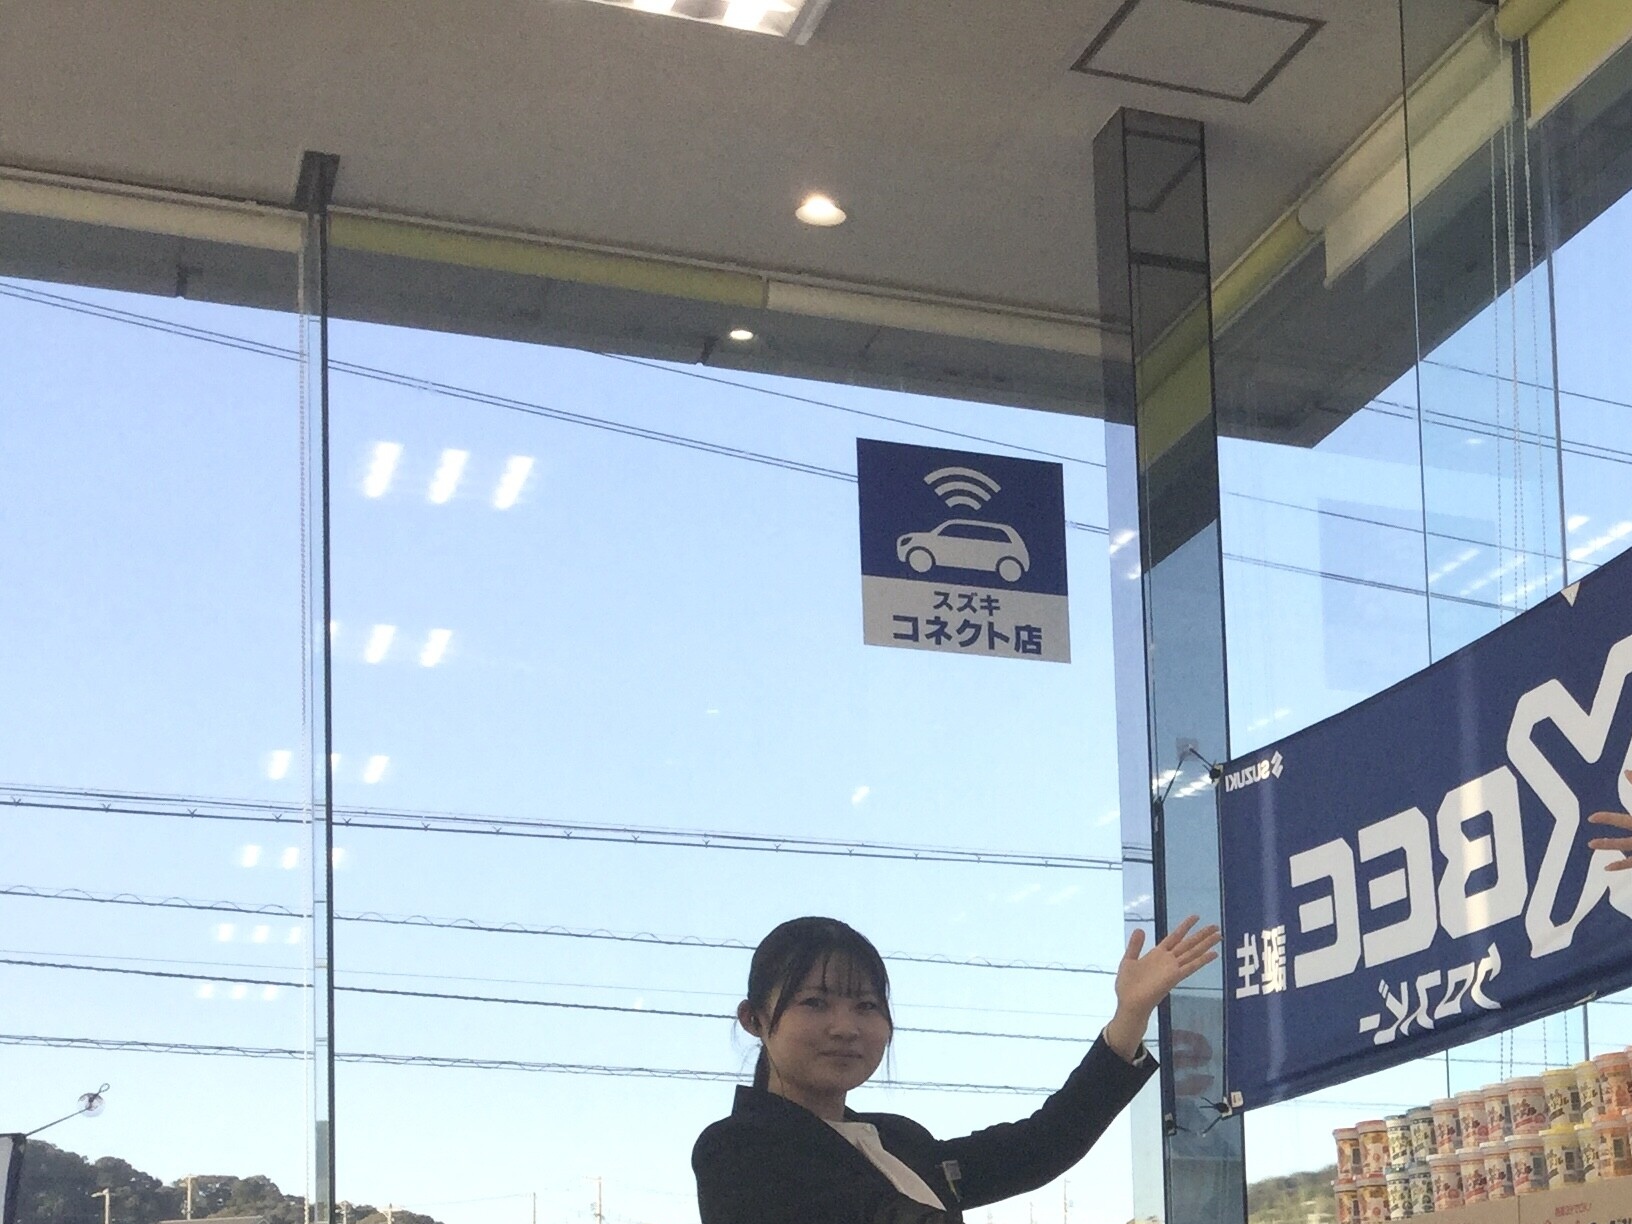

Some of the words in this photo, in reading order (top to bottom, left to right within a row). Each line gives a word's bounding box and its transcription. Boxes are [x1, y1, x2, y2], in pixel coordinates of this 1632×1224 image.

[932, 590, 1000, 616] スズキ
[892, 613, 1043, 656] コネクト店
